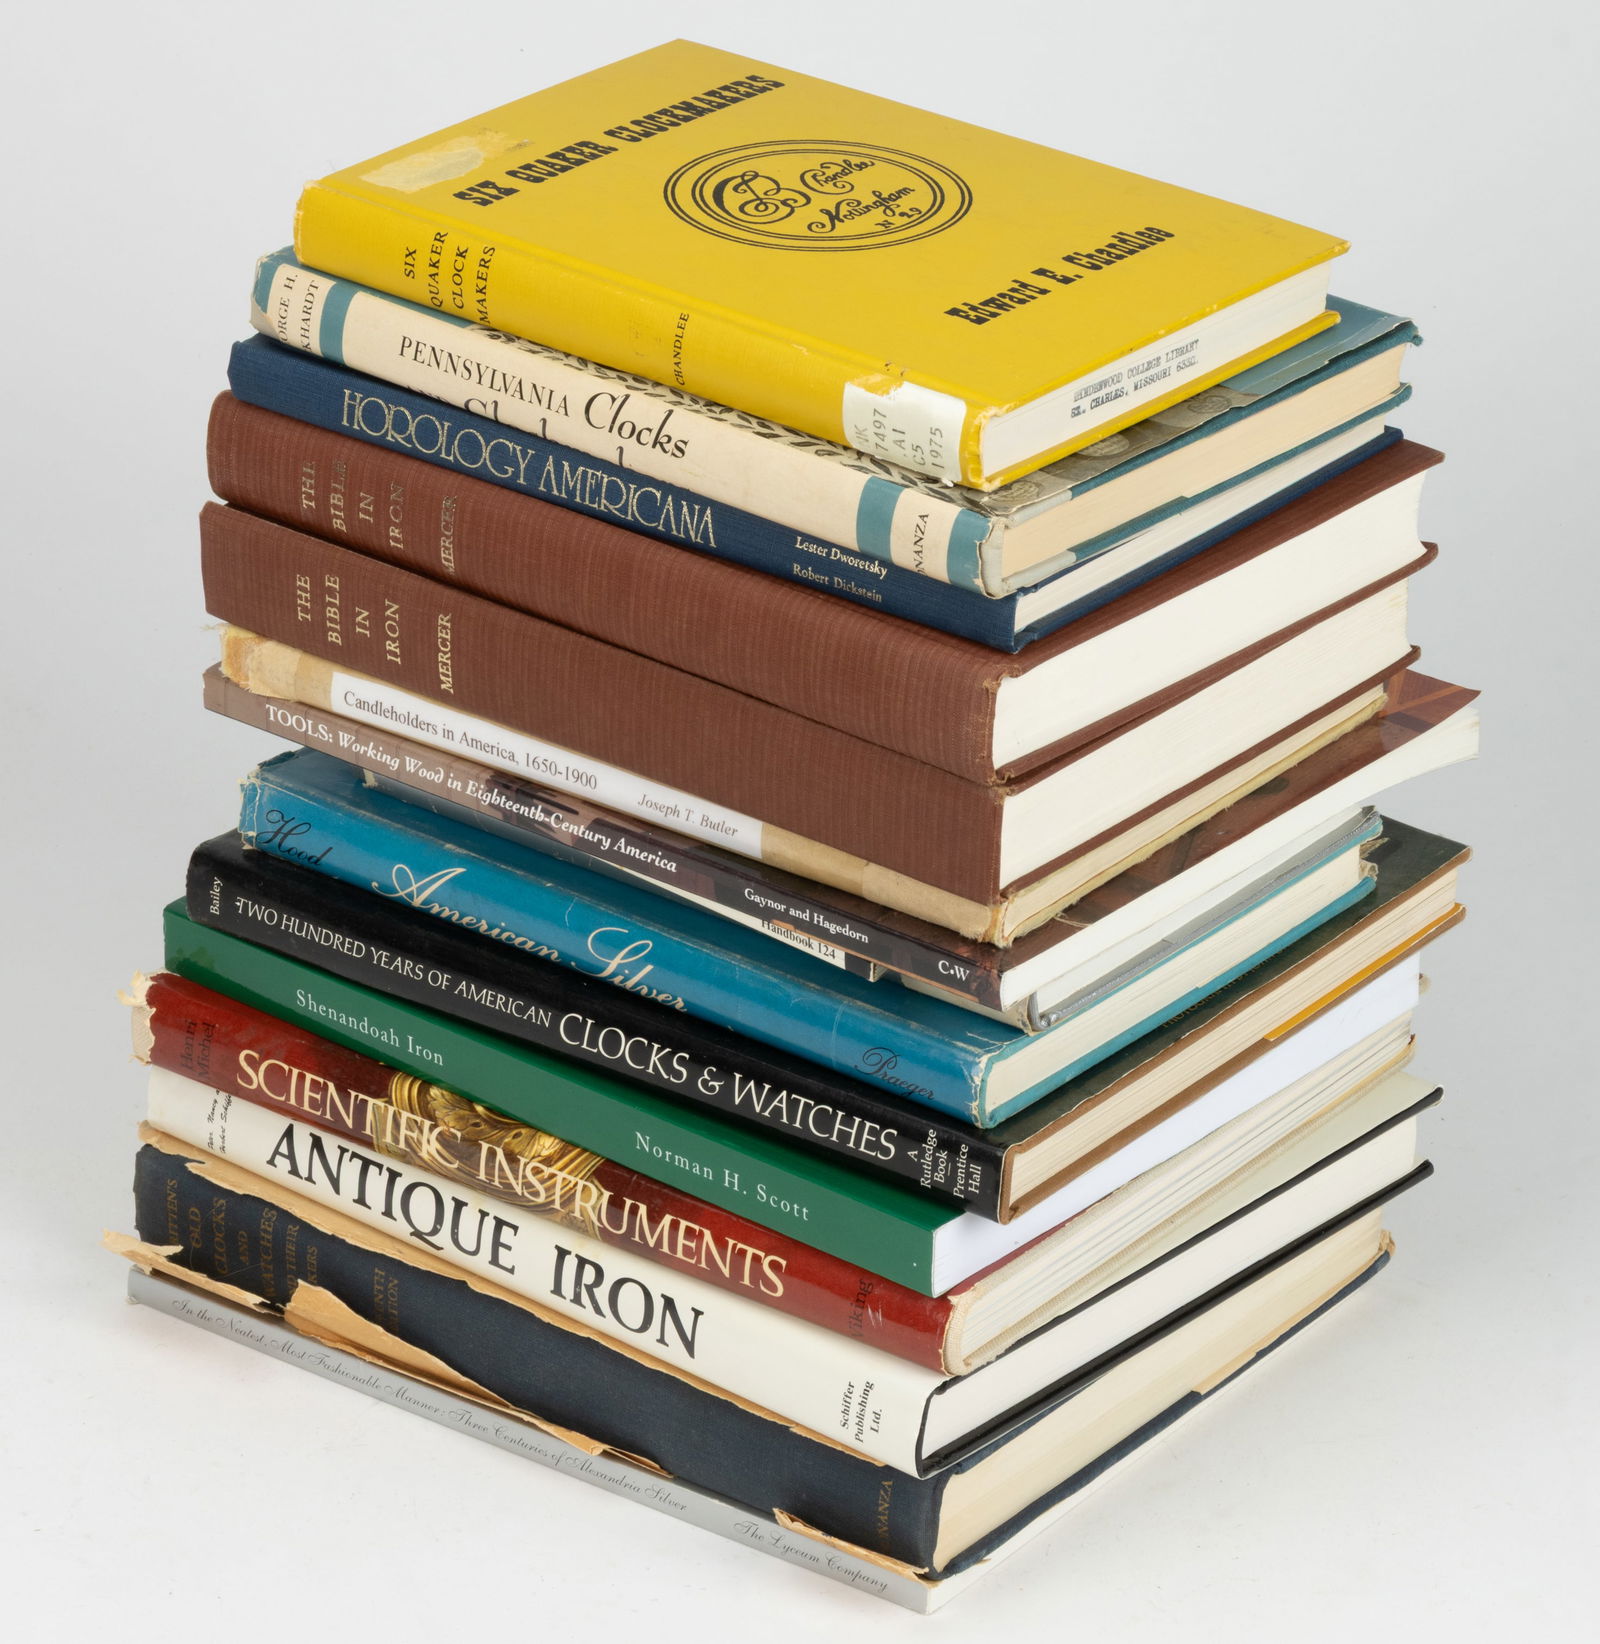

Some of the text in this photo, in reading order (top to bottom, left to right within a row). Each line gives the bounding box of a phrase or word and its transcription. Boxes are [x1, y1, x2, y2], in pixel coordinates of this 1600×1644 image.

[452, 75, 785, 206] SIX QUAKER CLOCKMAKERS
[283, 274, 298, 290] H.
[404, 246, 417, 279] SIX
[428, 231, 449, 308] QUAKER
[452, 245, 469, 309] CLOCK
[475, 246, 496, 326] MAKERS
[944, 226, 1175, 325] Edward E. Chandlee
[672, 312, 690, 386] CHANDLEE
[399, 335, 690, 459] PENNSYLVANIA Clocks
[1134, 366, 1171, 391] MISSOURI
[873, 408, 888, 452] 7497
[911, 443, 926, 466] C5
[929, 427, 945, 469] 1975
[341, 389, 717, 549] HOROLOGY AMERICANA
[359, 492, 375, 523] IN
[390, 481, 404, 550] IRON
[793, 563, 883, 603] Robert Dickstein
[795, 536, 888, 580] Lester Dworetsky
[296, 574, 312, 622] THE
[325, 574, 343, 646] BIBLE
[355, 606, 371, 638] IN
[385, 598, 401, 665] IRON
[437, 612, 454, 694] MERCER
[343, 690, 739, 838] Candleholders in America, 1650-1900 Joseph T. Butler
[256, 809, 333, 866] Hood
[265, 703, 335, 744] TOOLS:
[338, 730, 401, 770] Working
[403, 756, 444, 784] Wood
[447, 773, 463, 792] in
[465, 781, 611, 850] Eighteenth-Century
[613, 830, 678, 873] America
[744, 887, 787, 912] Gaynor
[789, 903, 810, 922] and
[813, 912, 869, 944] Hagedorn
[209, 877, 224, 916] Bailey
[370, 864, 688, 1013] American Silver
[761, 919, 835, 960] Handbook 124
[237, 896, 898, 1161] TWO HUNDRED YEARS OF AMERICAN CLOCKS & WATCHES
[854, 1047, 935, 1100] Praeger
[296, 988, 809, 1221] Shenandoah Iron Norman H. Scott
[236, 1049, 787, 1298] SCIENTIFIC INSTRUMENTS
[906, 1150, 919, 1162] A
[920, 1129, 938, 1189] Rutledge
[933, 1149, 948, 1183] Book
[953, 1144, 969, 1199] Prentice
[968, 1164, 982, 1194] Hall
[188, 1207, 202, 1248] OLD
[212, 1197, 228, 1274] CLOCKS
[238, 1230, 249, 1265] AND
[266, 1122, 704, 1360] ANTIQUE IRON
[840, 1381, 855, 1430] Schiffer
[854, 1380, 875, 1443] Publishing
[870, 1408, 882, 1434] Ltd.
[172, 1300, 194, 1318] In
[194, 1307, 213, 1323] the
[215, 1316, 268, 1347] Neatest,
[270, 1338, 306, 1360] Most
[306, 1353, 382, 1390] Fashionable
[448, 1409, 489, 1432] Three
[492, 1422, 549, 1458] Centuries
[551, 1451, 564, 1467] of
[565, 1456, 641, 1493] Alexandria
[644, 1484, 688, 1512] Silver
[734, 1520, 765, 1541] The
[769, 1530, 820, 1563] Lyceum
[825, 1552, 888, 1593] Company
